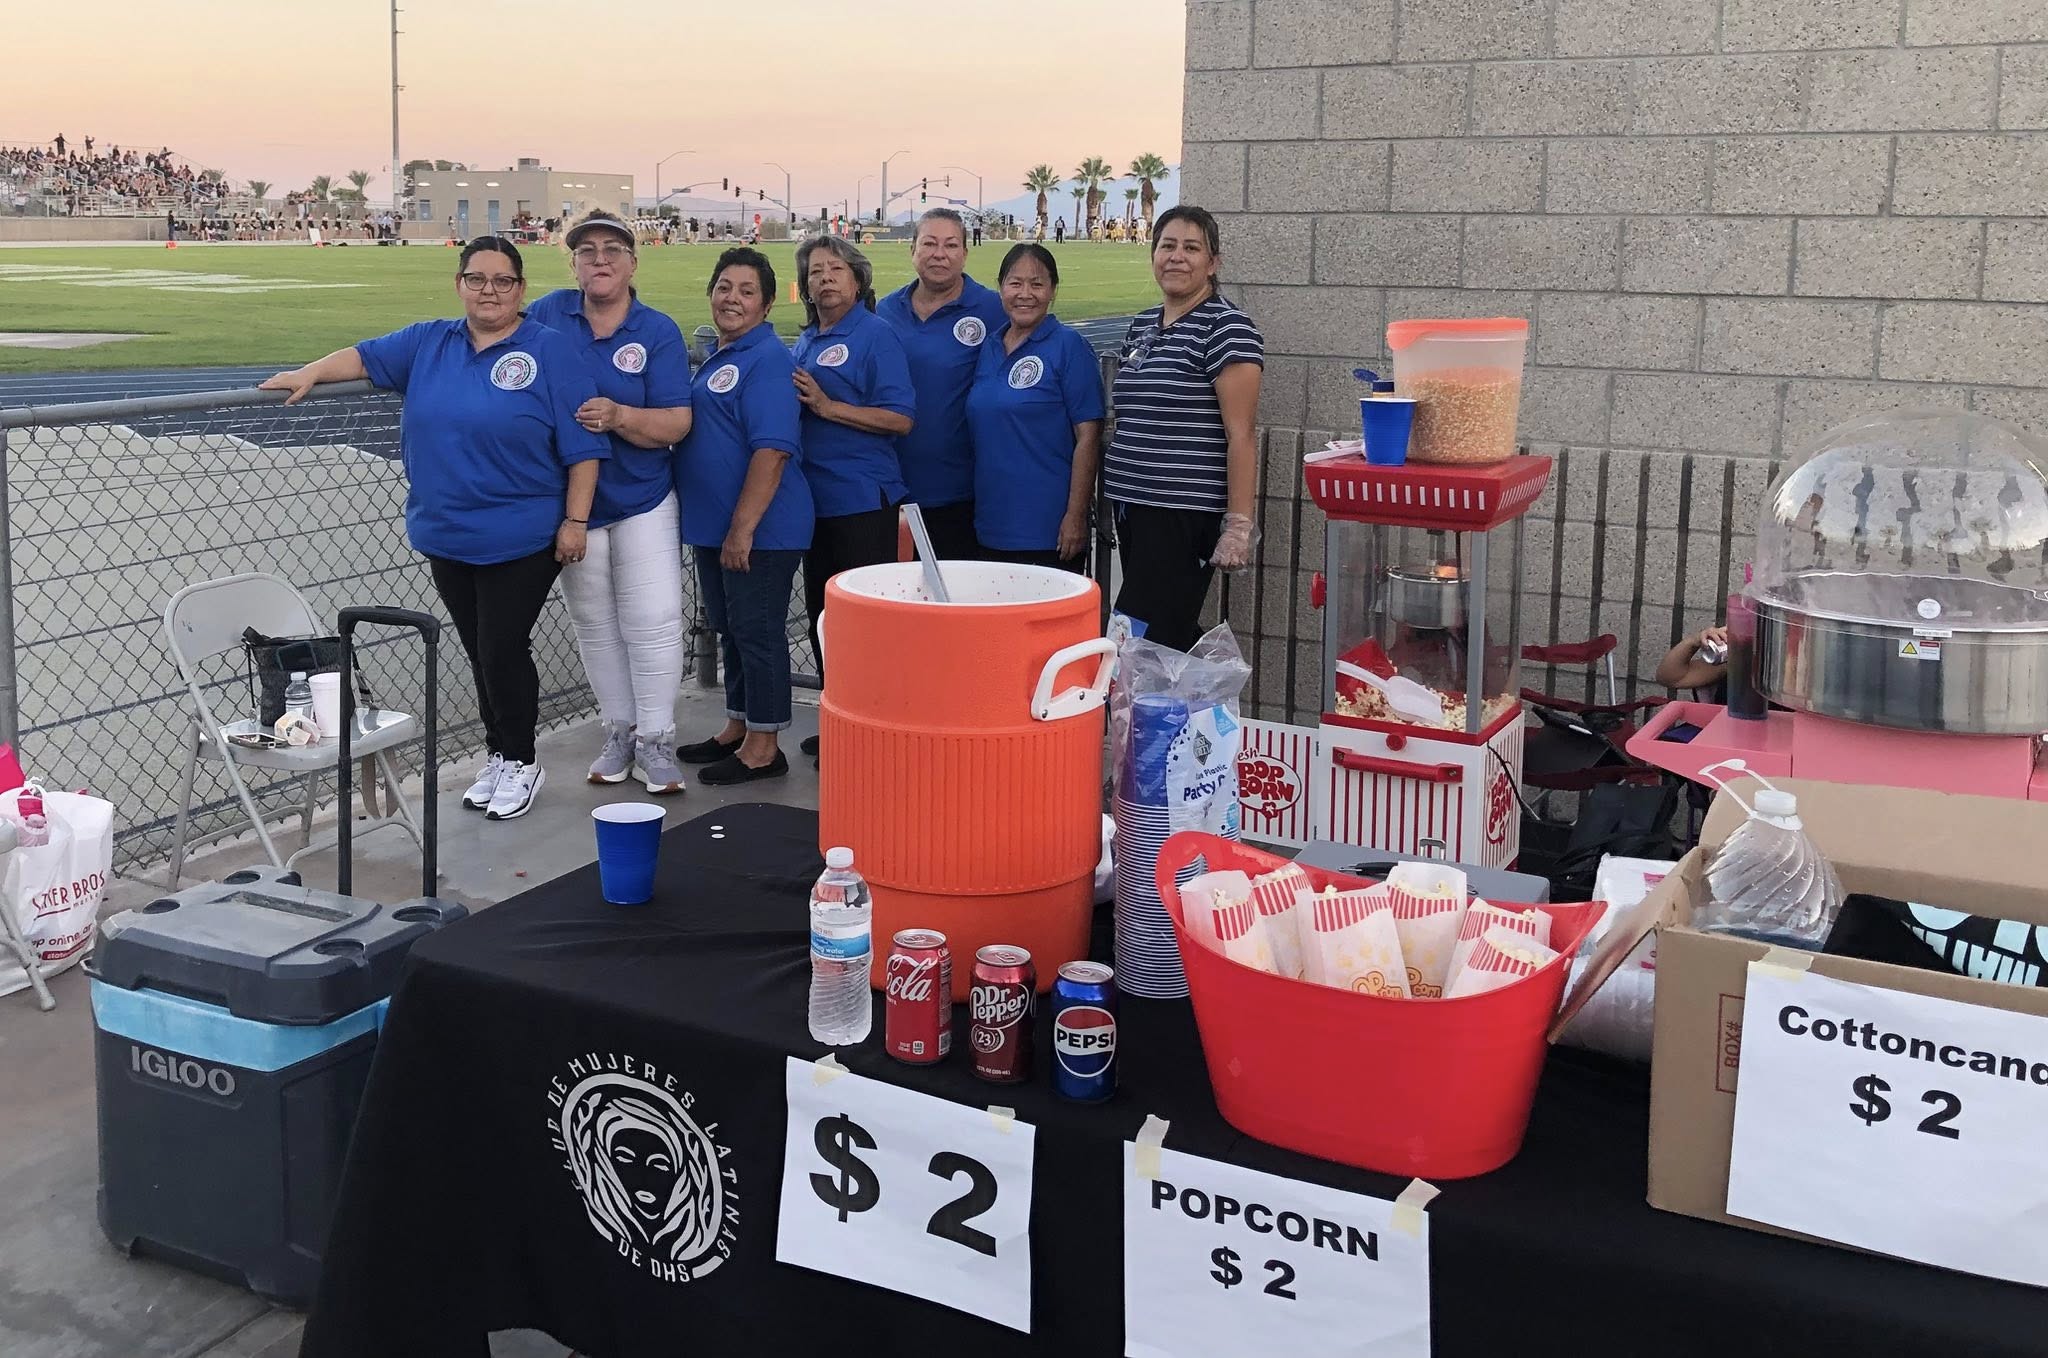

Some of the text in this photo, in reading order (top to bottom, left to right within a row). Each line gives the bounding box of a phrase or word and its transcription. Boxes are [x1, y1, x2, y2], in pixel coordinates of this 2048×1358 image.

[1237, 747, 1260, 761] esh
[1203, 764, 1228, 777] Plastic
[1237, 760, 1284, 783] POP
[1183, 780, 1216, 801] Party
[1239, 775, 1294, 802] CORN
[72, 870, 105, 899] BROS
[970, 986, 1026, 1025] Pepper
[984, 985, 1011, 1006] Dr
[978, 1031, 991, 1047] 23
[1056, 1027, 1114, 1049] PEPSI
[131, 1045, 236, 1096] IGLOO
[1849, 1073, 1963, 1141] $ 2
[547, 1075, 569, 1108] DE
[567, 1052, 696, 1110] MUJERES
[703, 1121, 740, 1260] LATINAS
[809, 1112, 999, 1258] $ 2
[1151, 1178, 1380, 1262] POPCORN
[618, 1238, 691, 1284] DE DHS
[1209, 1245, 1297, 1301] $ 2
